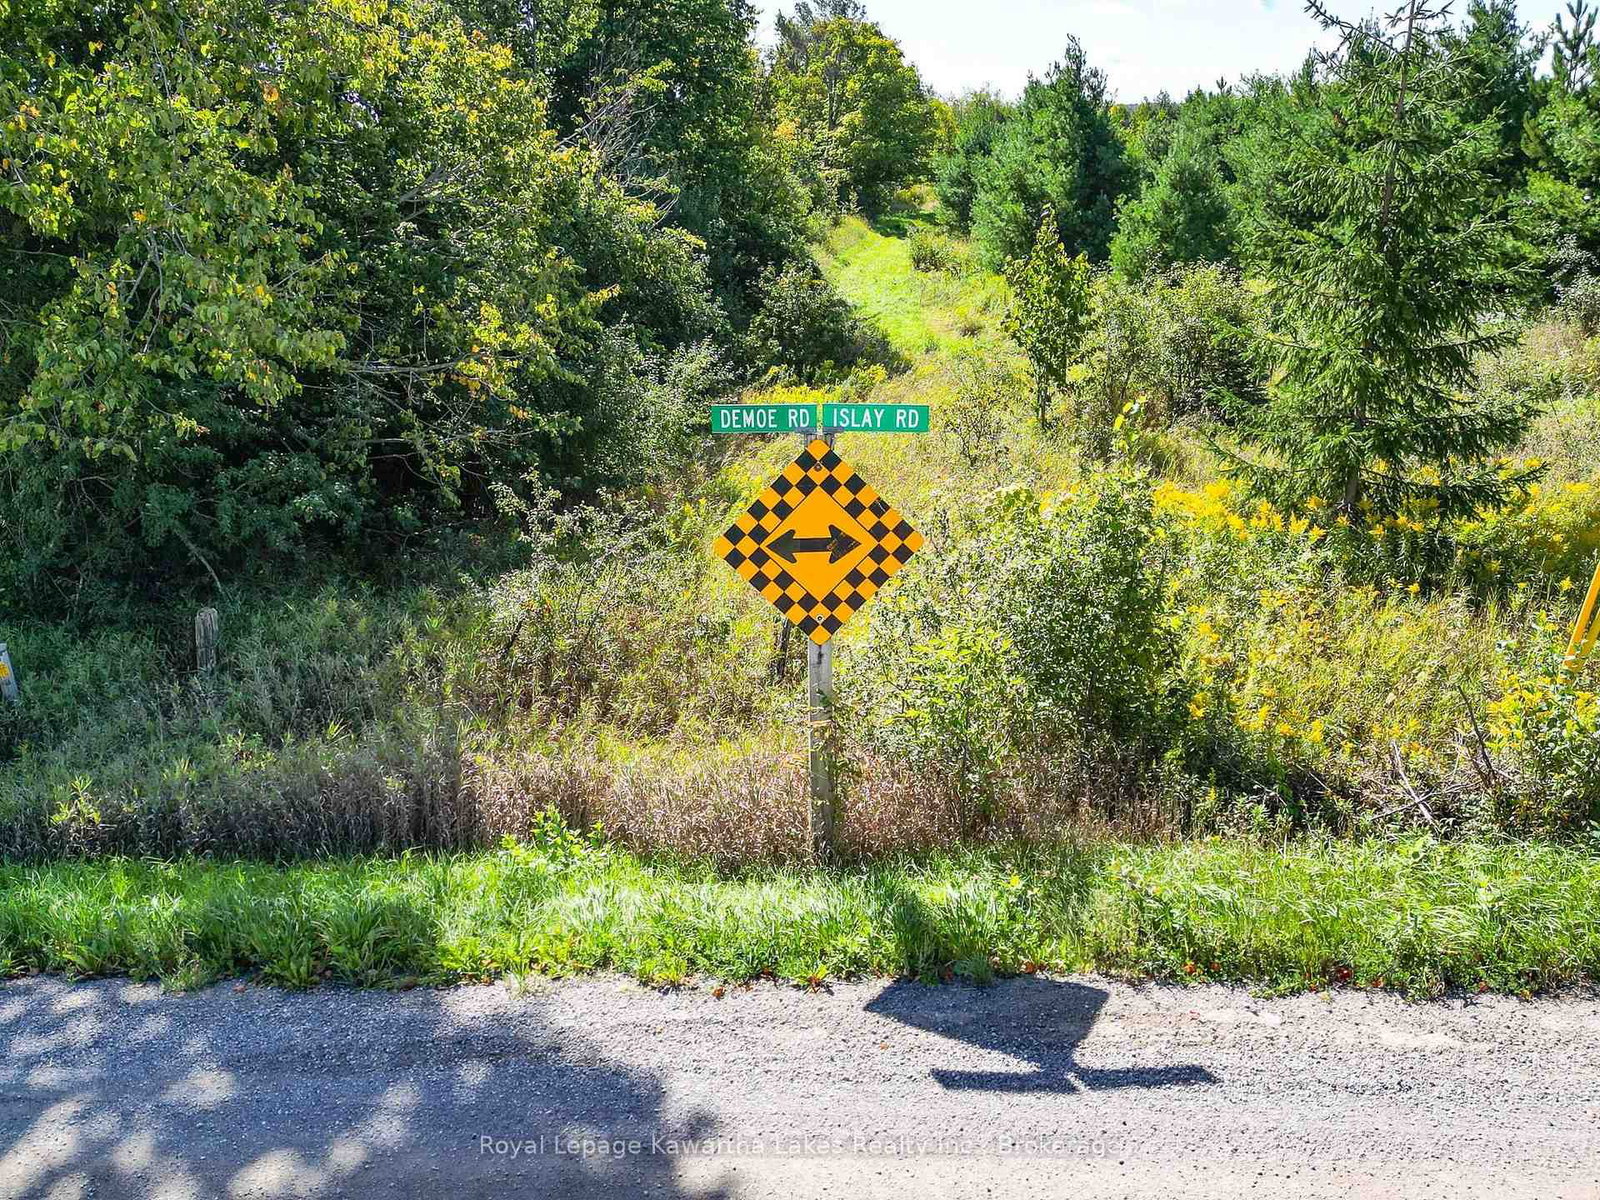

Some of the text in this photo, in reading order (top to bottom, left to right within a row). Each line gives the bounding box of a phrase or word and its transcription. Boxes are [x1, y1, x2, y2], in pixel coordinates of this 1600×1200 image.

[720, 408, 810, 429] DEMOE RD
[833, 408, 919, 428] ISLAY RD
